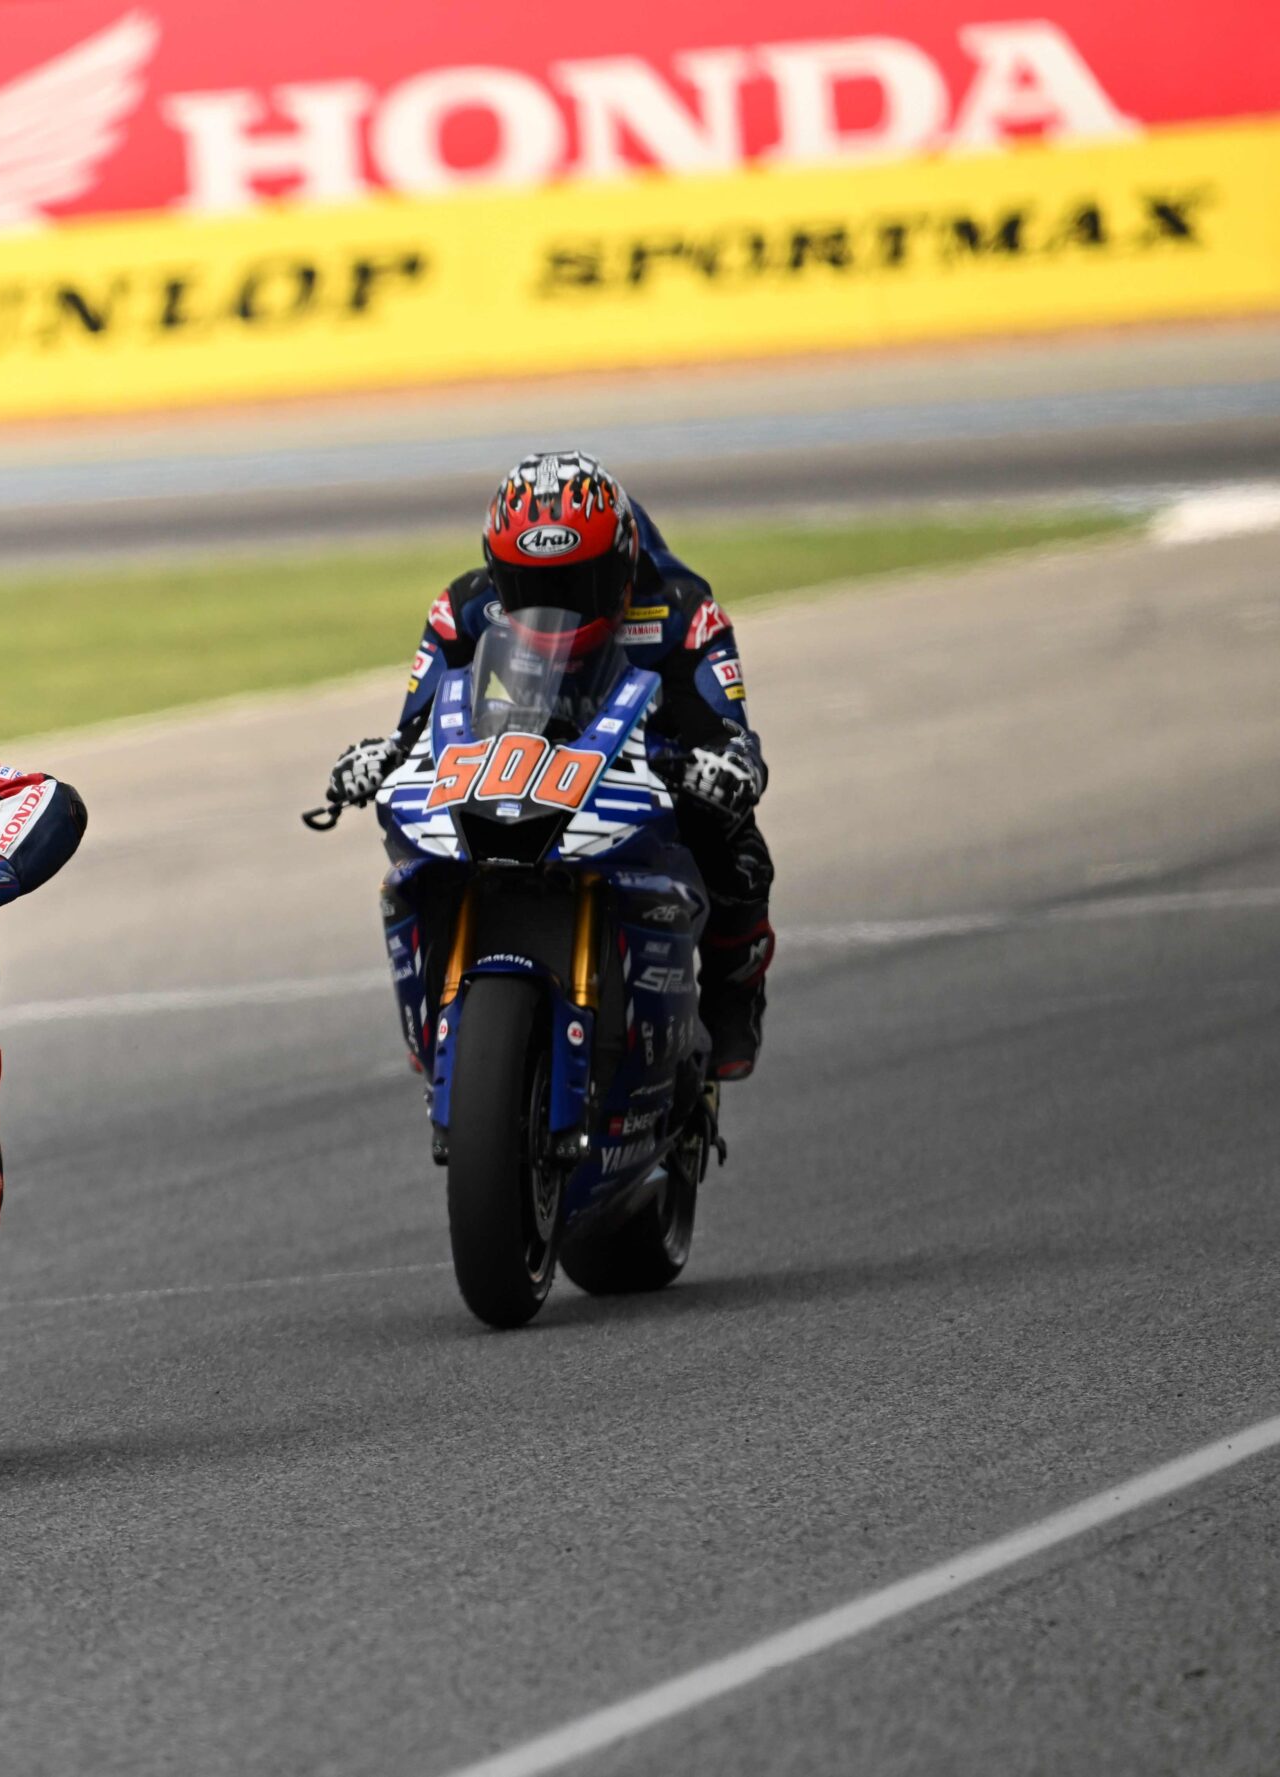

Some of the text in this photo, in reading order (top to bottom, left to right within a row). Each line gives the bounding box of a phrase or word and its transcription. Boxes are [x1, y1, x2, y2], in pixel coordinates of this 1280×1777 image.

[161, 19, 1145, 220] HONDA
[534, 184, 1216, 300] SPORTMAX
[523, 531, 572, 550] Arai
[422, 732, 607, 814] 500
[476, 953, 534, 969] YAMAHA
